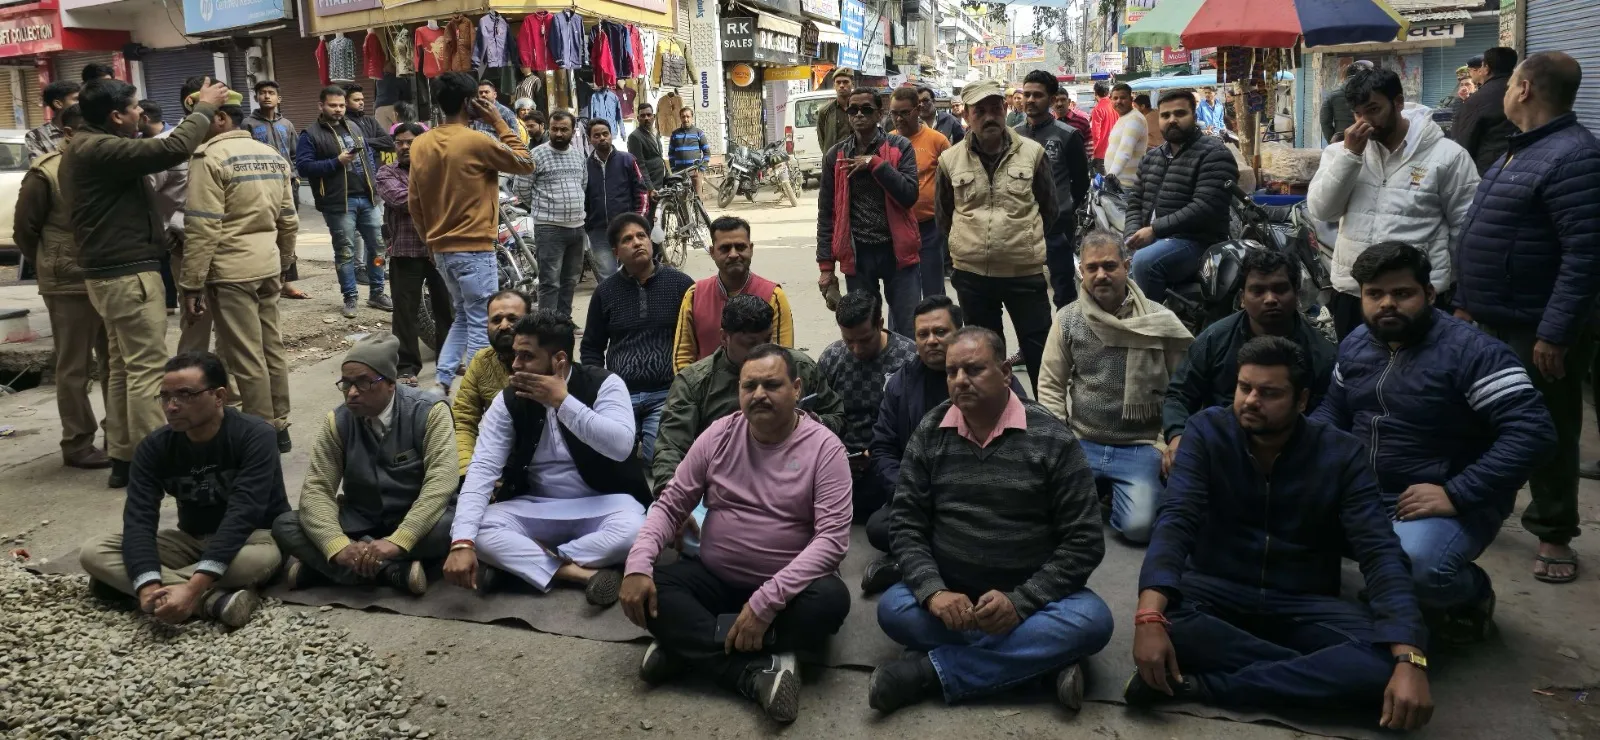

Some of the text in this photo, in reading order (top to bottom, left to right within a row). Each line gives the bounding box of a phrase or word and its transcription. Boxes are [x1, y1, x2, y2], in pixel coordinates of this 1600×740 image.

[11, 24, 53, 43] COLLECTION
[727, 23, 749, 34] R.K
[724, 39, 753, 48] SALES
[776, 34, 798, 54] SALES
[771, 69, 801, 77] realme
